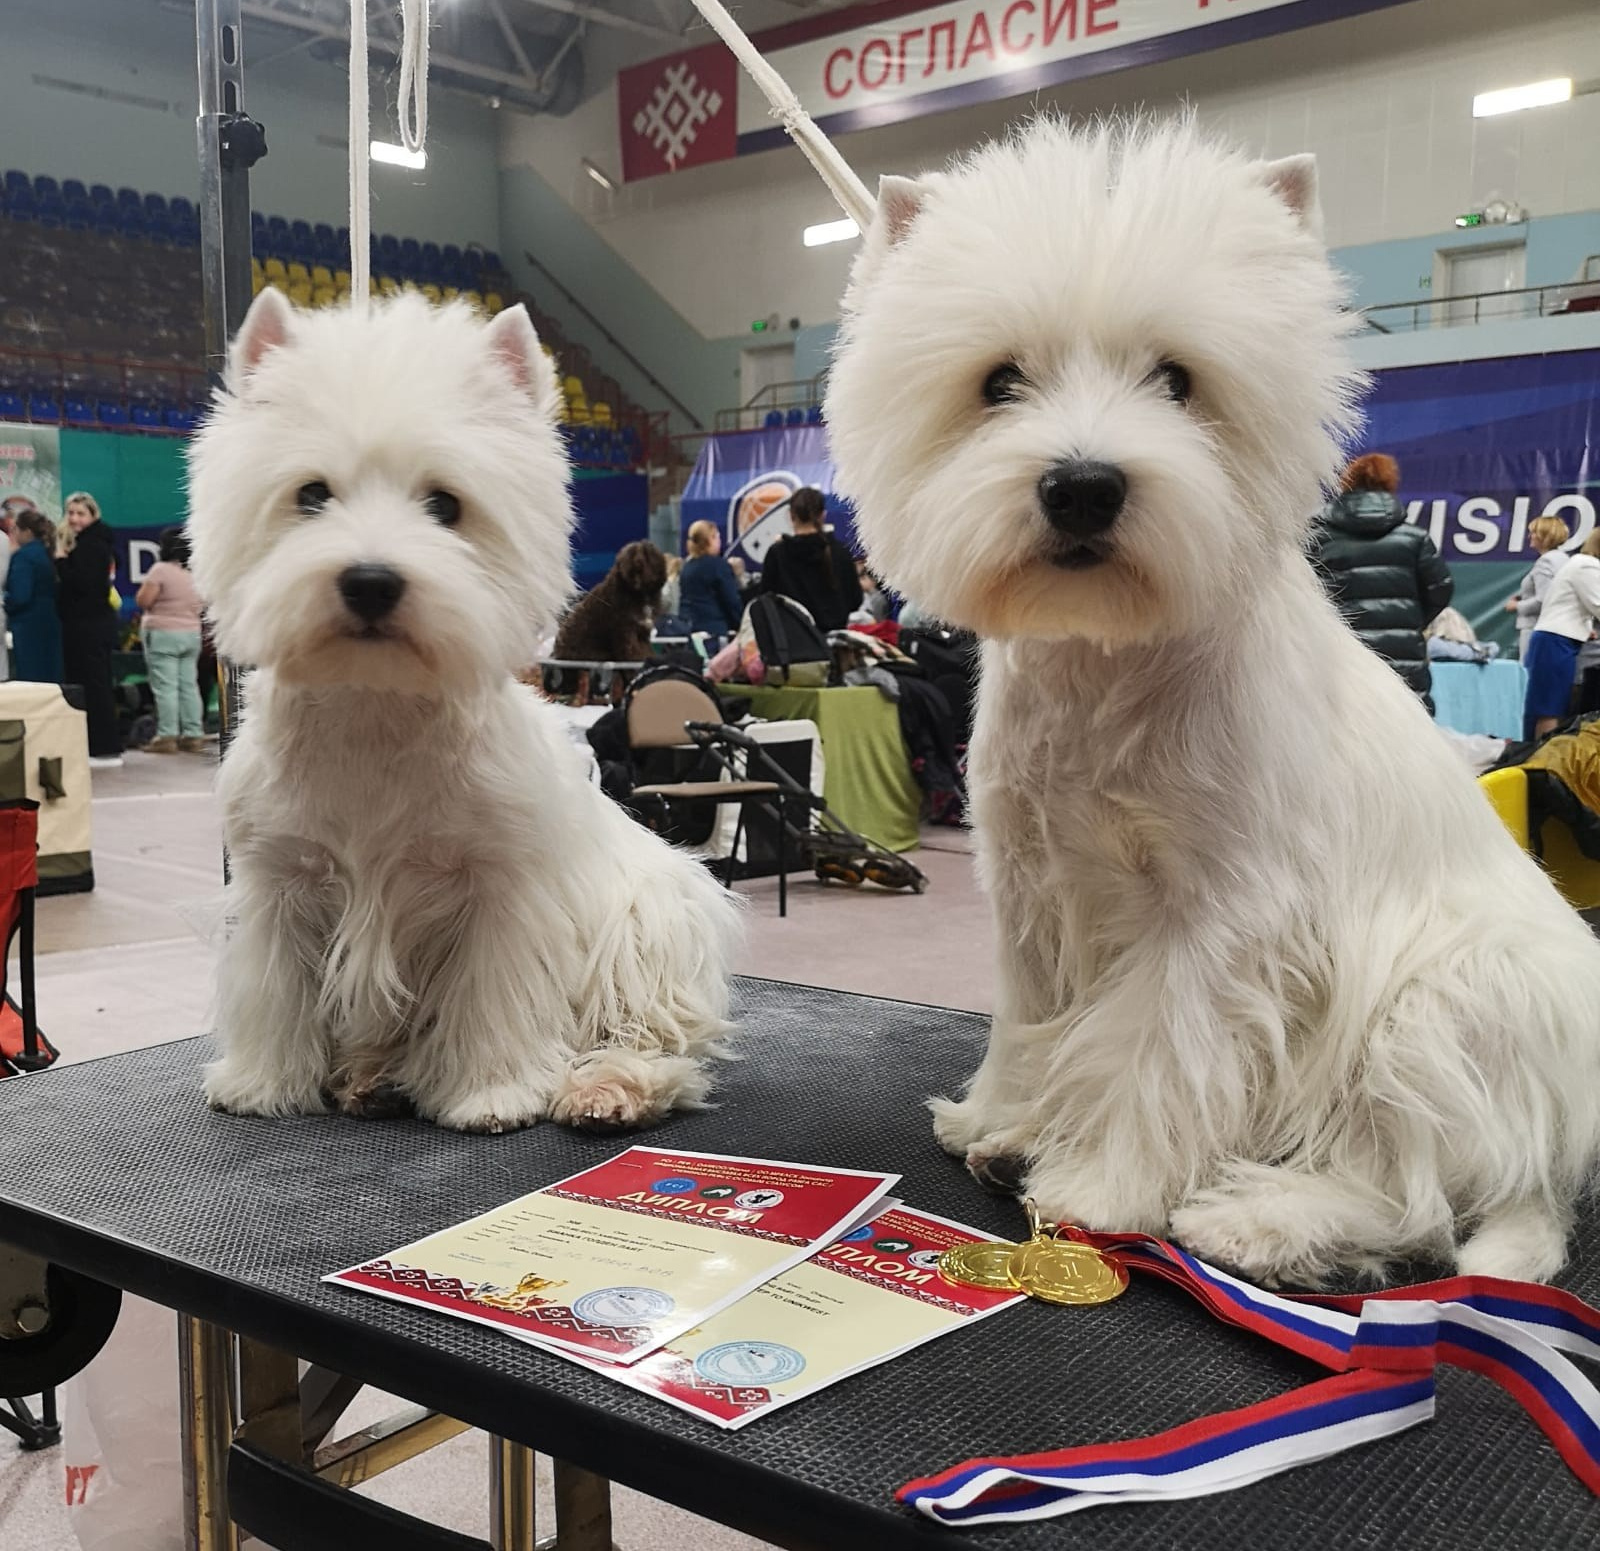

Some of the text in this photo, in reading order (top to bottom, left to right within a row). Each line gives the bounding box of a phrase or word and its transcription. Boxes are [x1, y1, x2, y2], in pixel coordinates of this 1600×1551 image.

[824, 0, 1119, 99] СОГЛАСИЕ
[1405, 494, 1596, 555] ISIO
[617, 1191, 764, 1224] ДИПЛОМ
